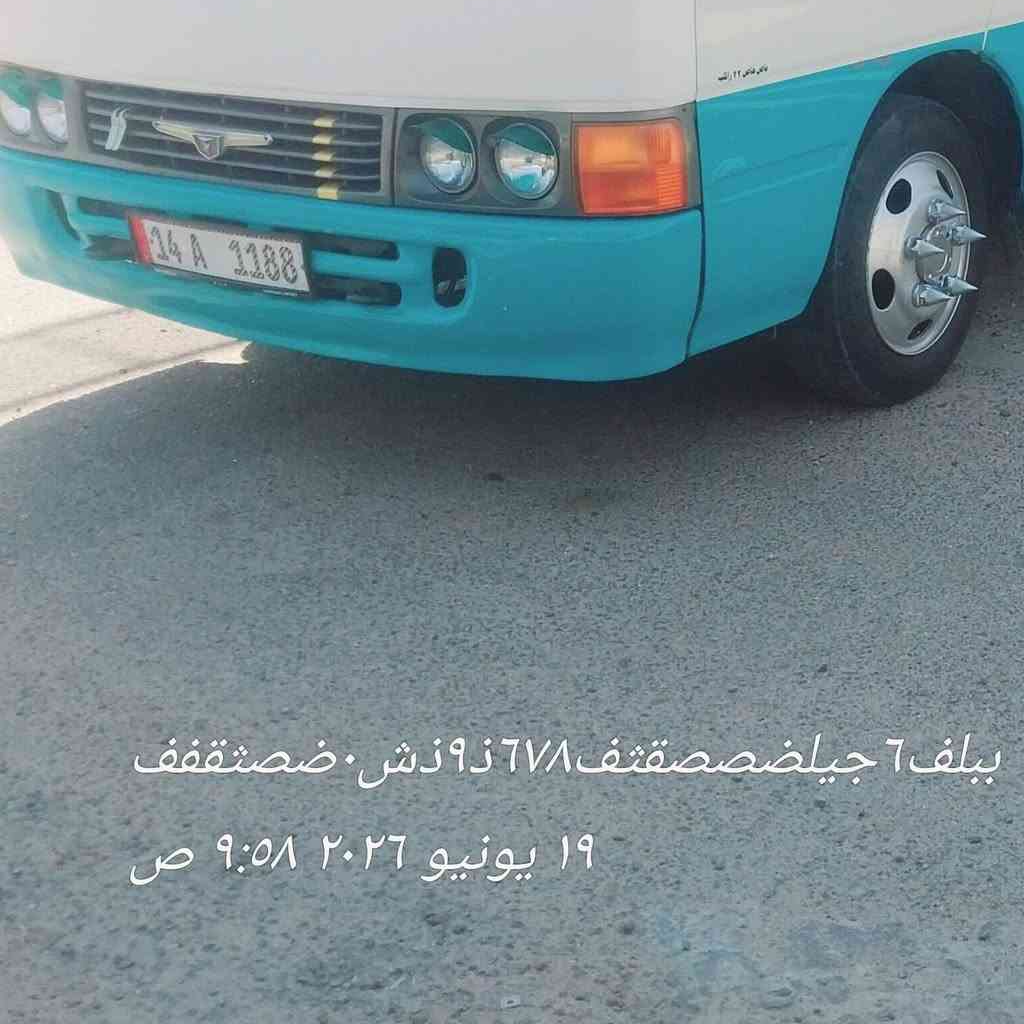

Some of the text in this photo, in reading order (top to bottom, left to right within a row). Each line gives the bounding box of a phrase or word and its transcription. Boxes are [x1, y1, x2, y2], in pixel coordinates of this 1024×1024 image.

[151, 225, 298, 284] 14 A 1188
